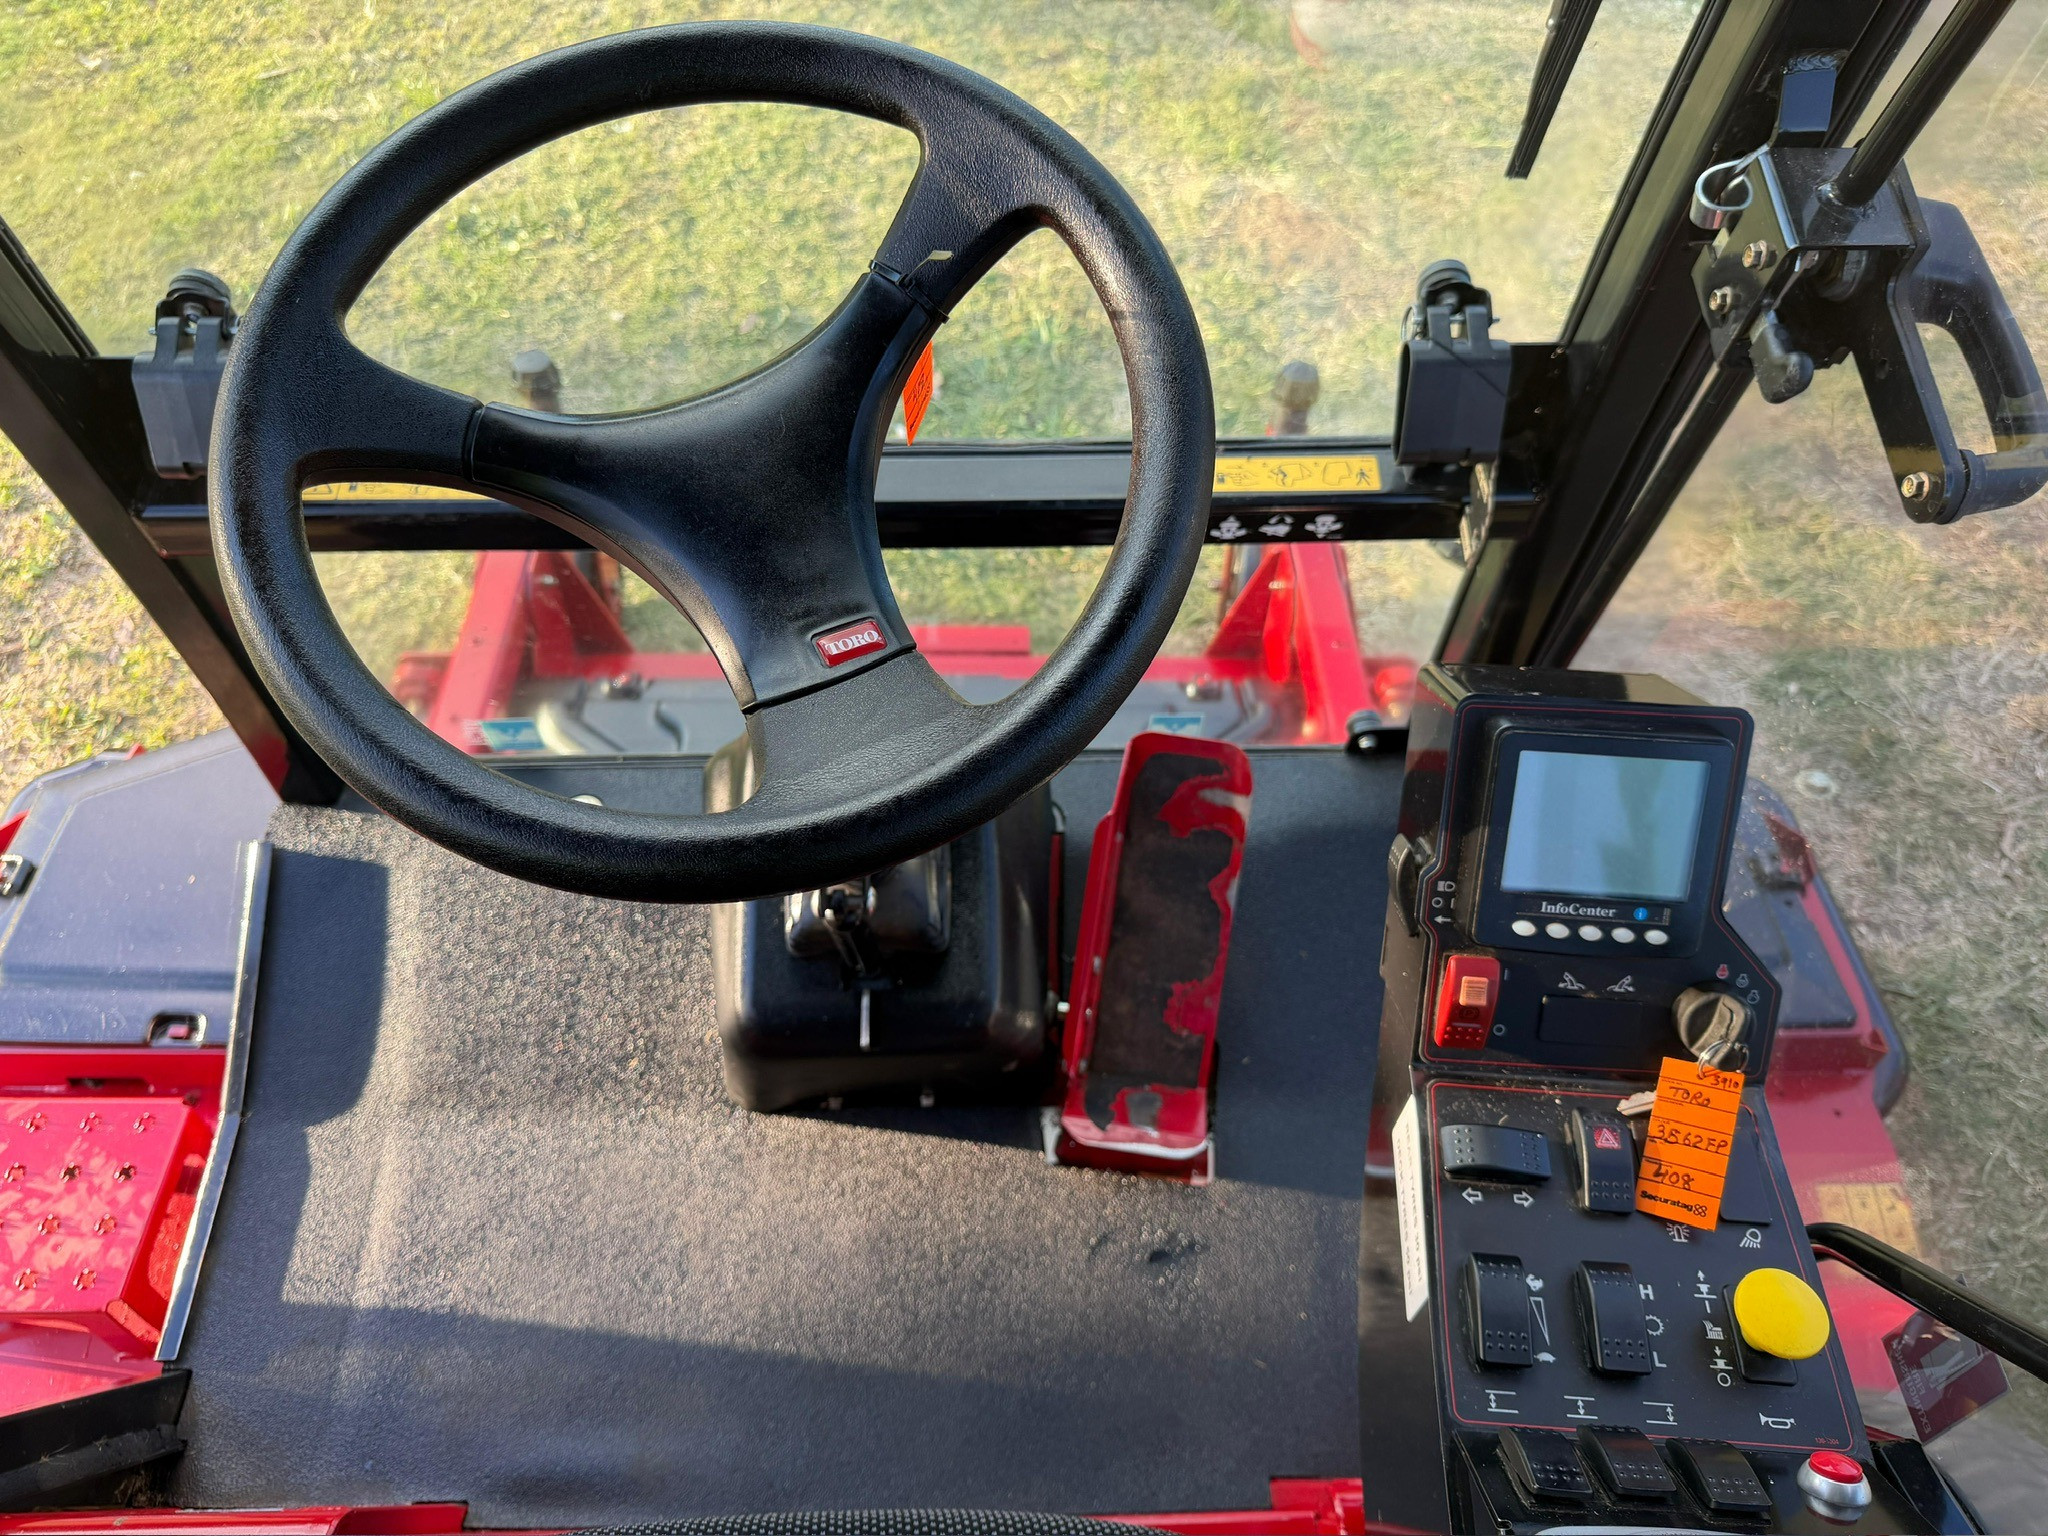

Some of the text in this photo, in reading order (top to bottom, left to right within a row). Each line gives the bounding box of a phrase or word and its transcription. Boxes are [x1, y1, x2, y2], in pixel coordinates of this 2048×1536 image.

[825, 630, 880, 655] TORO
[1541, 901, 1617, 918] InfoCenter
[1669, 1086, 1711, 1107] TORO
[1639, 1284, 1654, 1300] H
[1653, 1351, 1667, 1368] L
